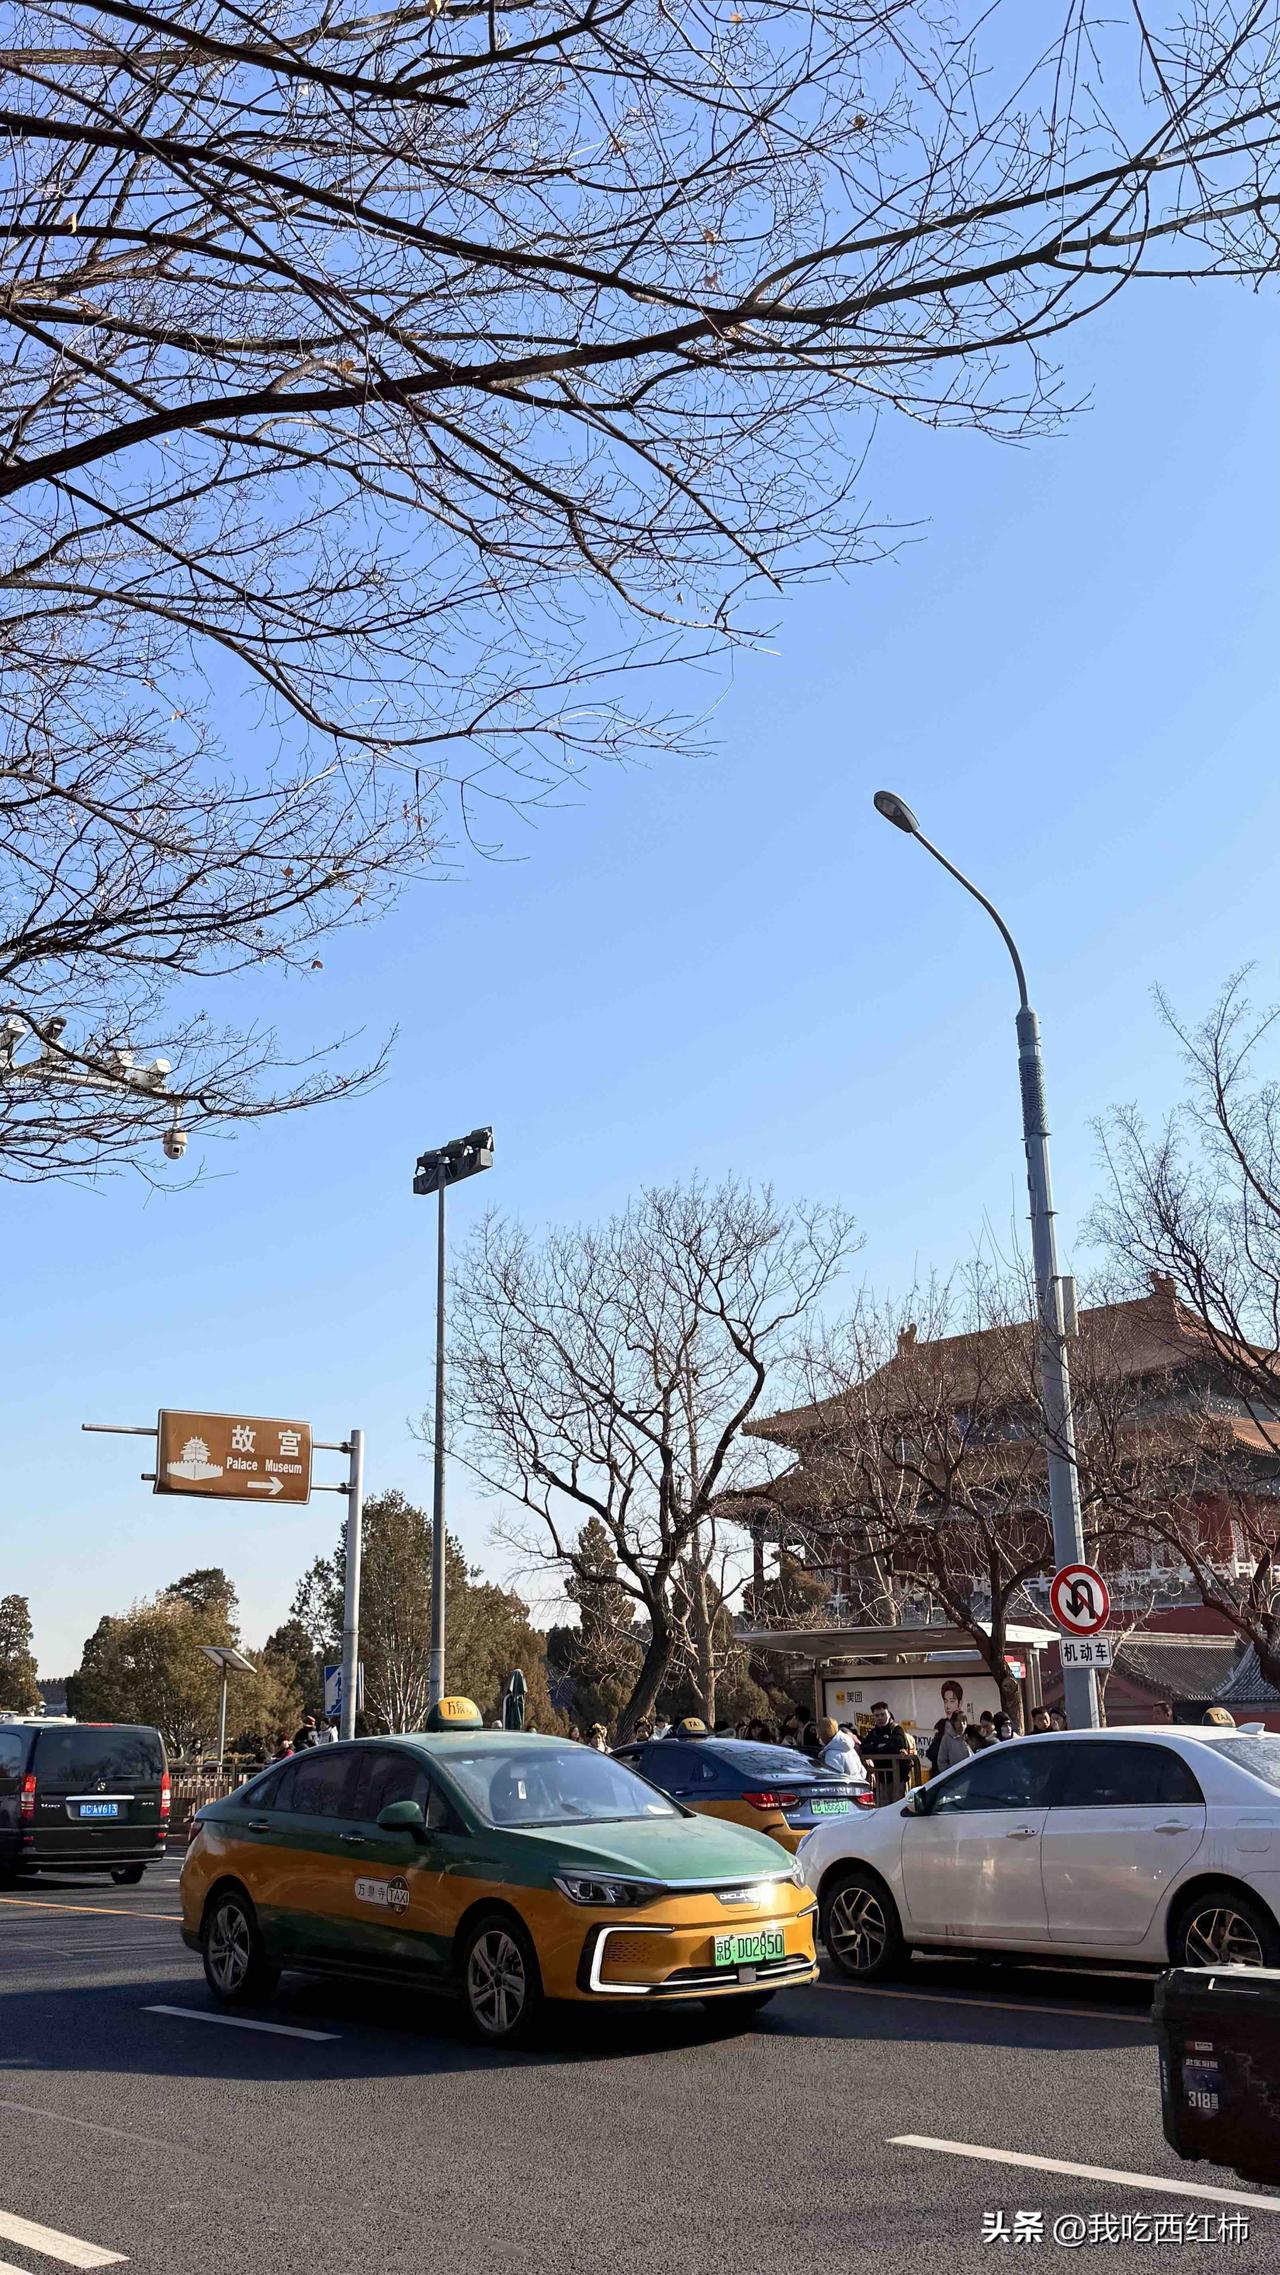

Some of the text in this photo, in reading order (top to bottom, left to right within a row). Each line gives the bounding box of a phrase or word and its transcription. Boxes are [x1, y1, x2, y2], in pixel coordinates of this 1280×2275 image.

[231, 1424, 302, 1457] 故宫
[226, 1456, 302, 1474] Palace Museum
[1063, 1643, 1108, 1662] 机动车
[846, 1691, 863, 1703] 美团
[389, 1888, 409, 1905] TAXI
[1188, 2091, 1211, 2109] 318
